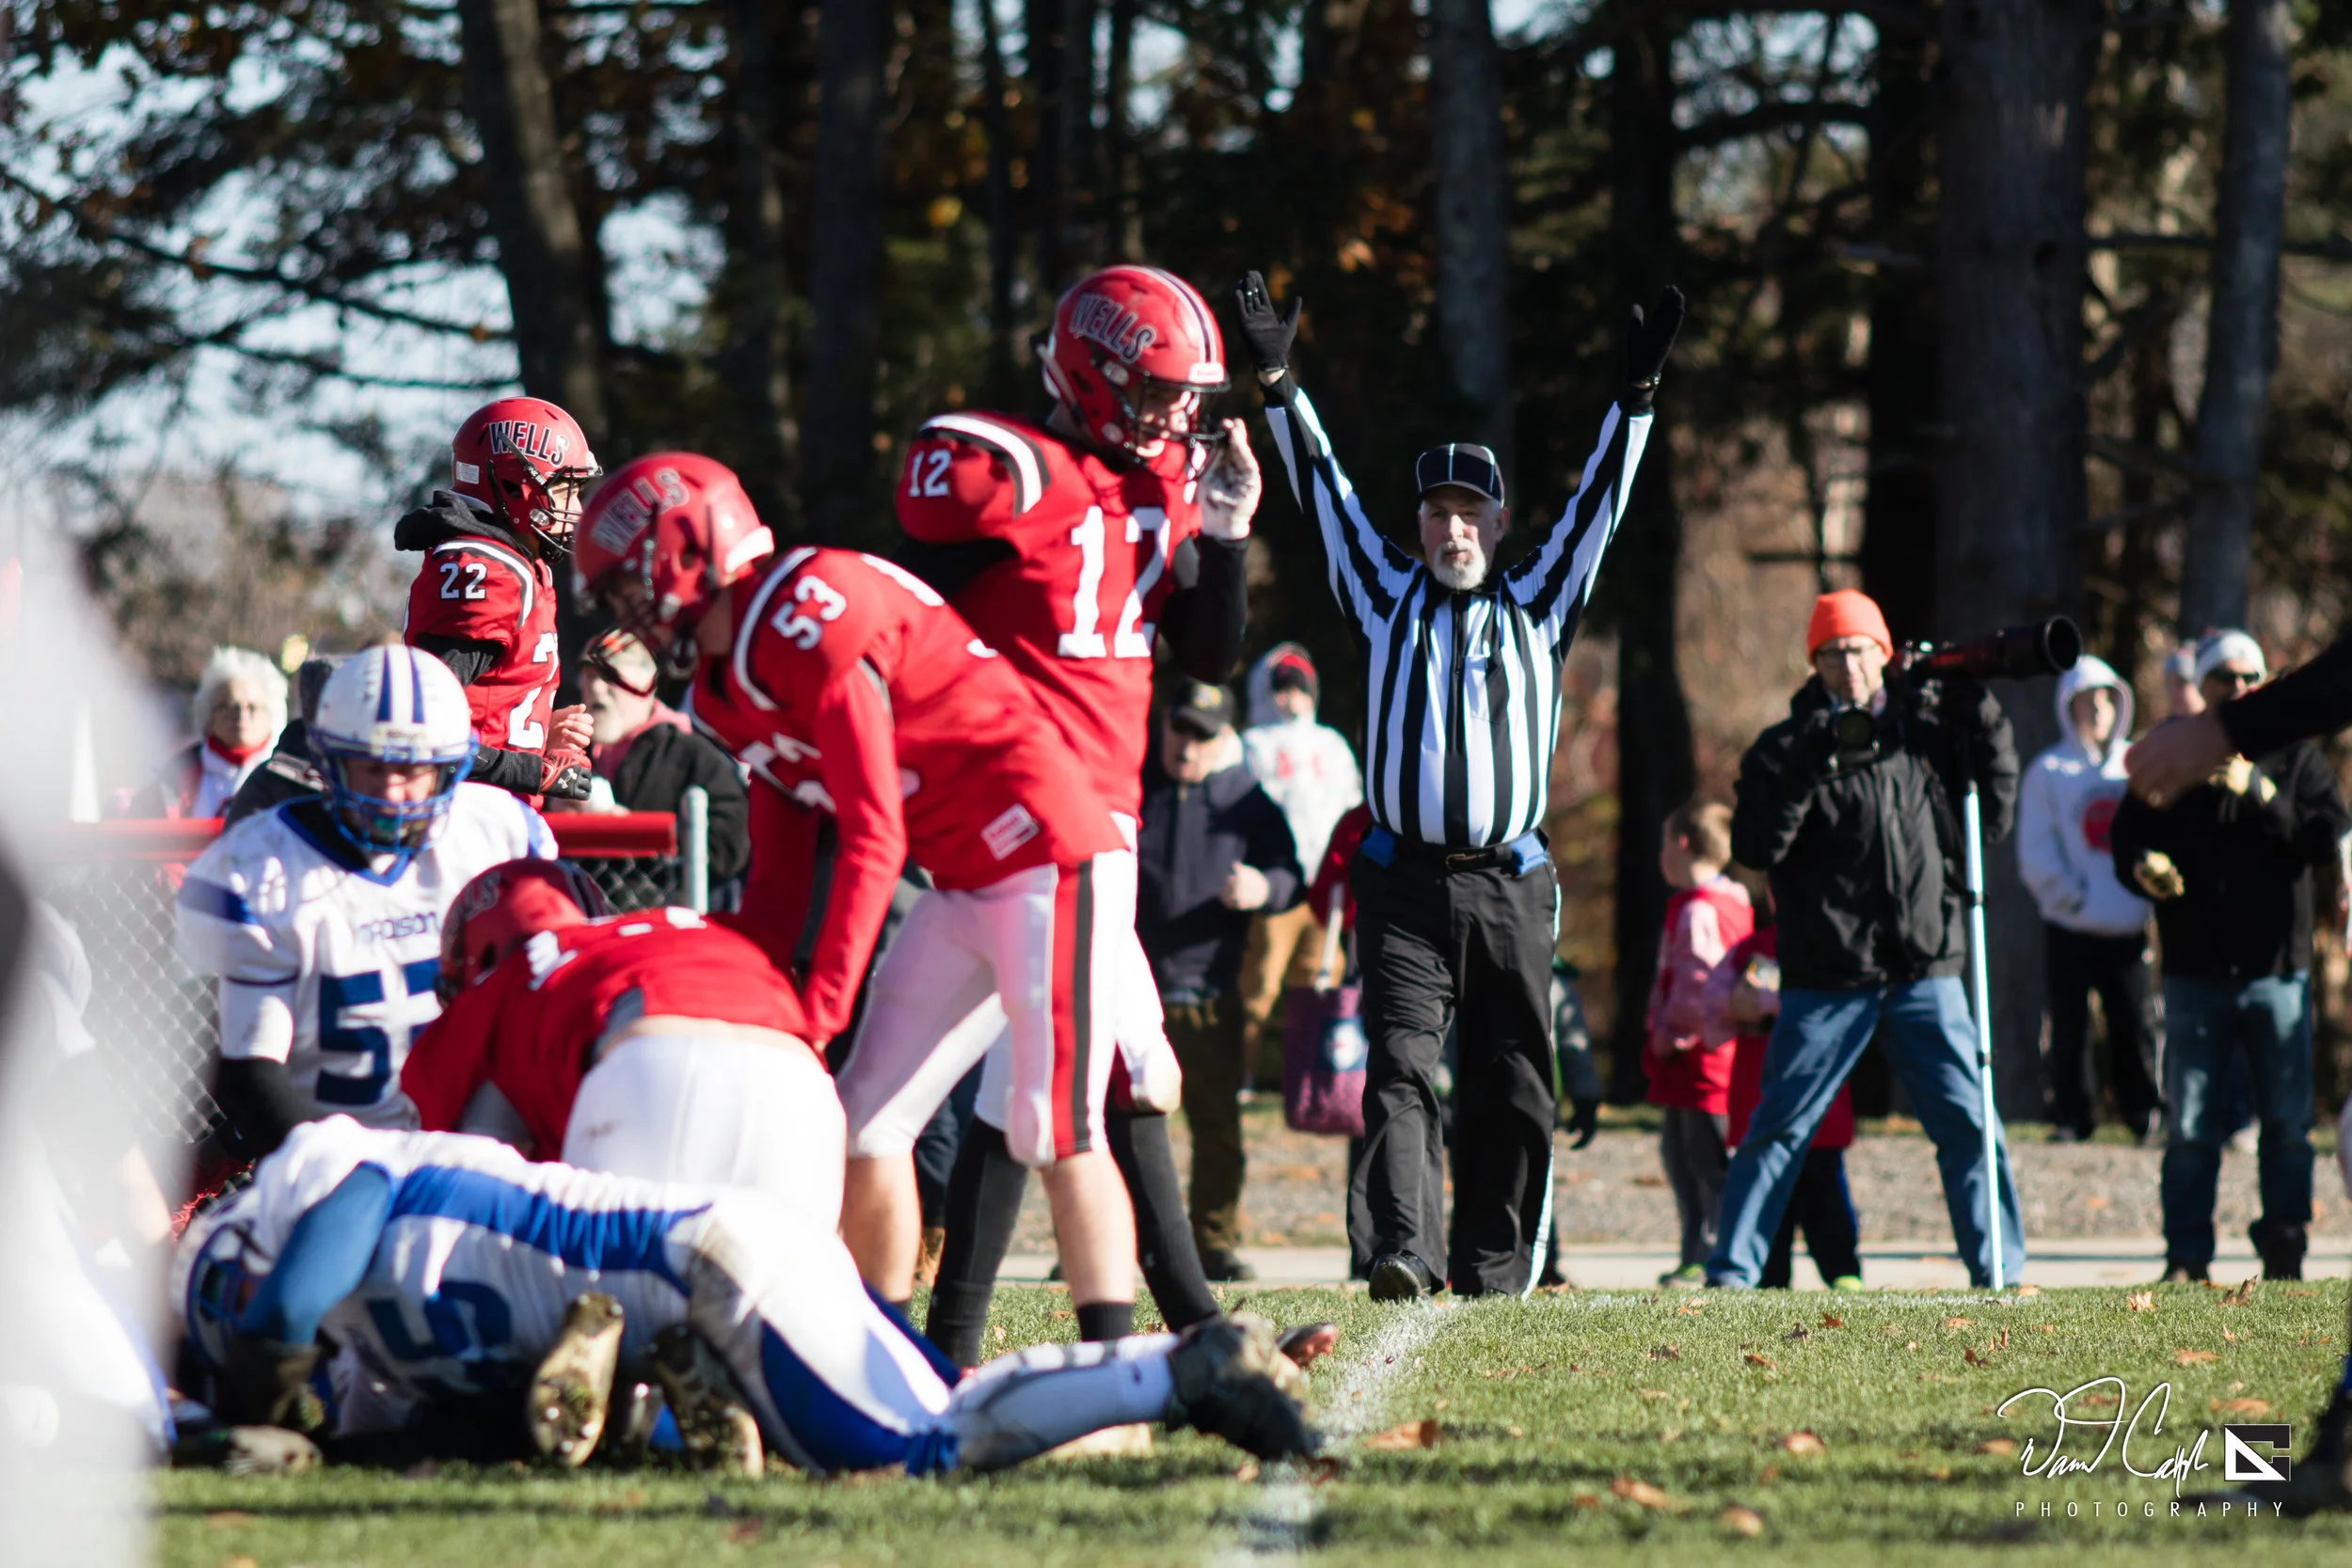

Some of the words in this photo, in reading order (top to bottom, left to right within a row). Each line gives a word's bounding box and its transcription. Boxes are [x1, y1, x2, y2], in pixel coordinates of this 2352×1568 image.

[1069, 293, 1157, 364] WELLS
[489, 420, 569, 467] WELLS
[908, 450, 952, 498] 12
[590, 467, 691, 558] WELLS
[439, 562, 487, 600] 22
[771, 574, 847, 651] 53
[1057, 505, 1171, 658] 12
[507, 631, 560, 750] 2
